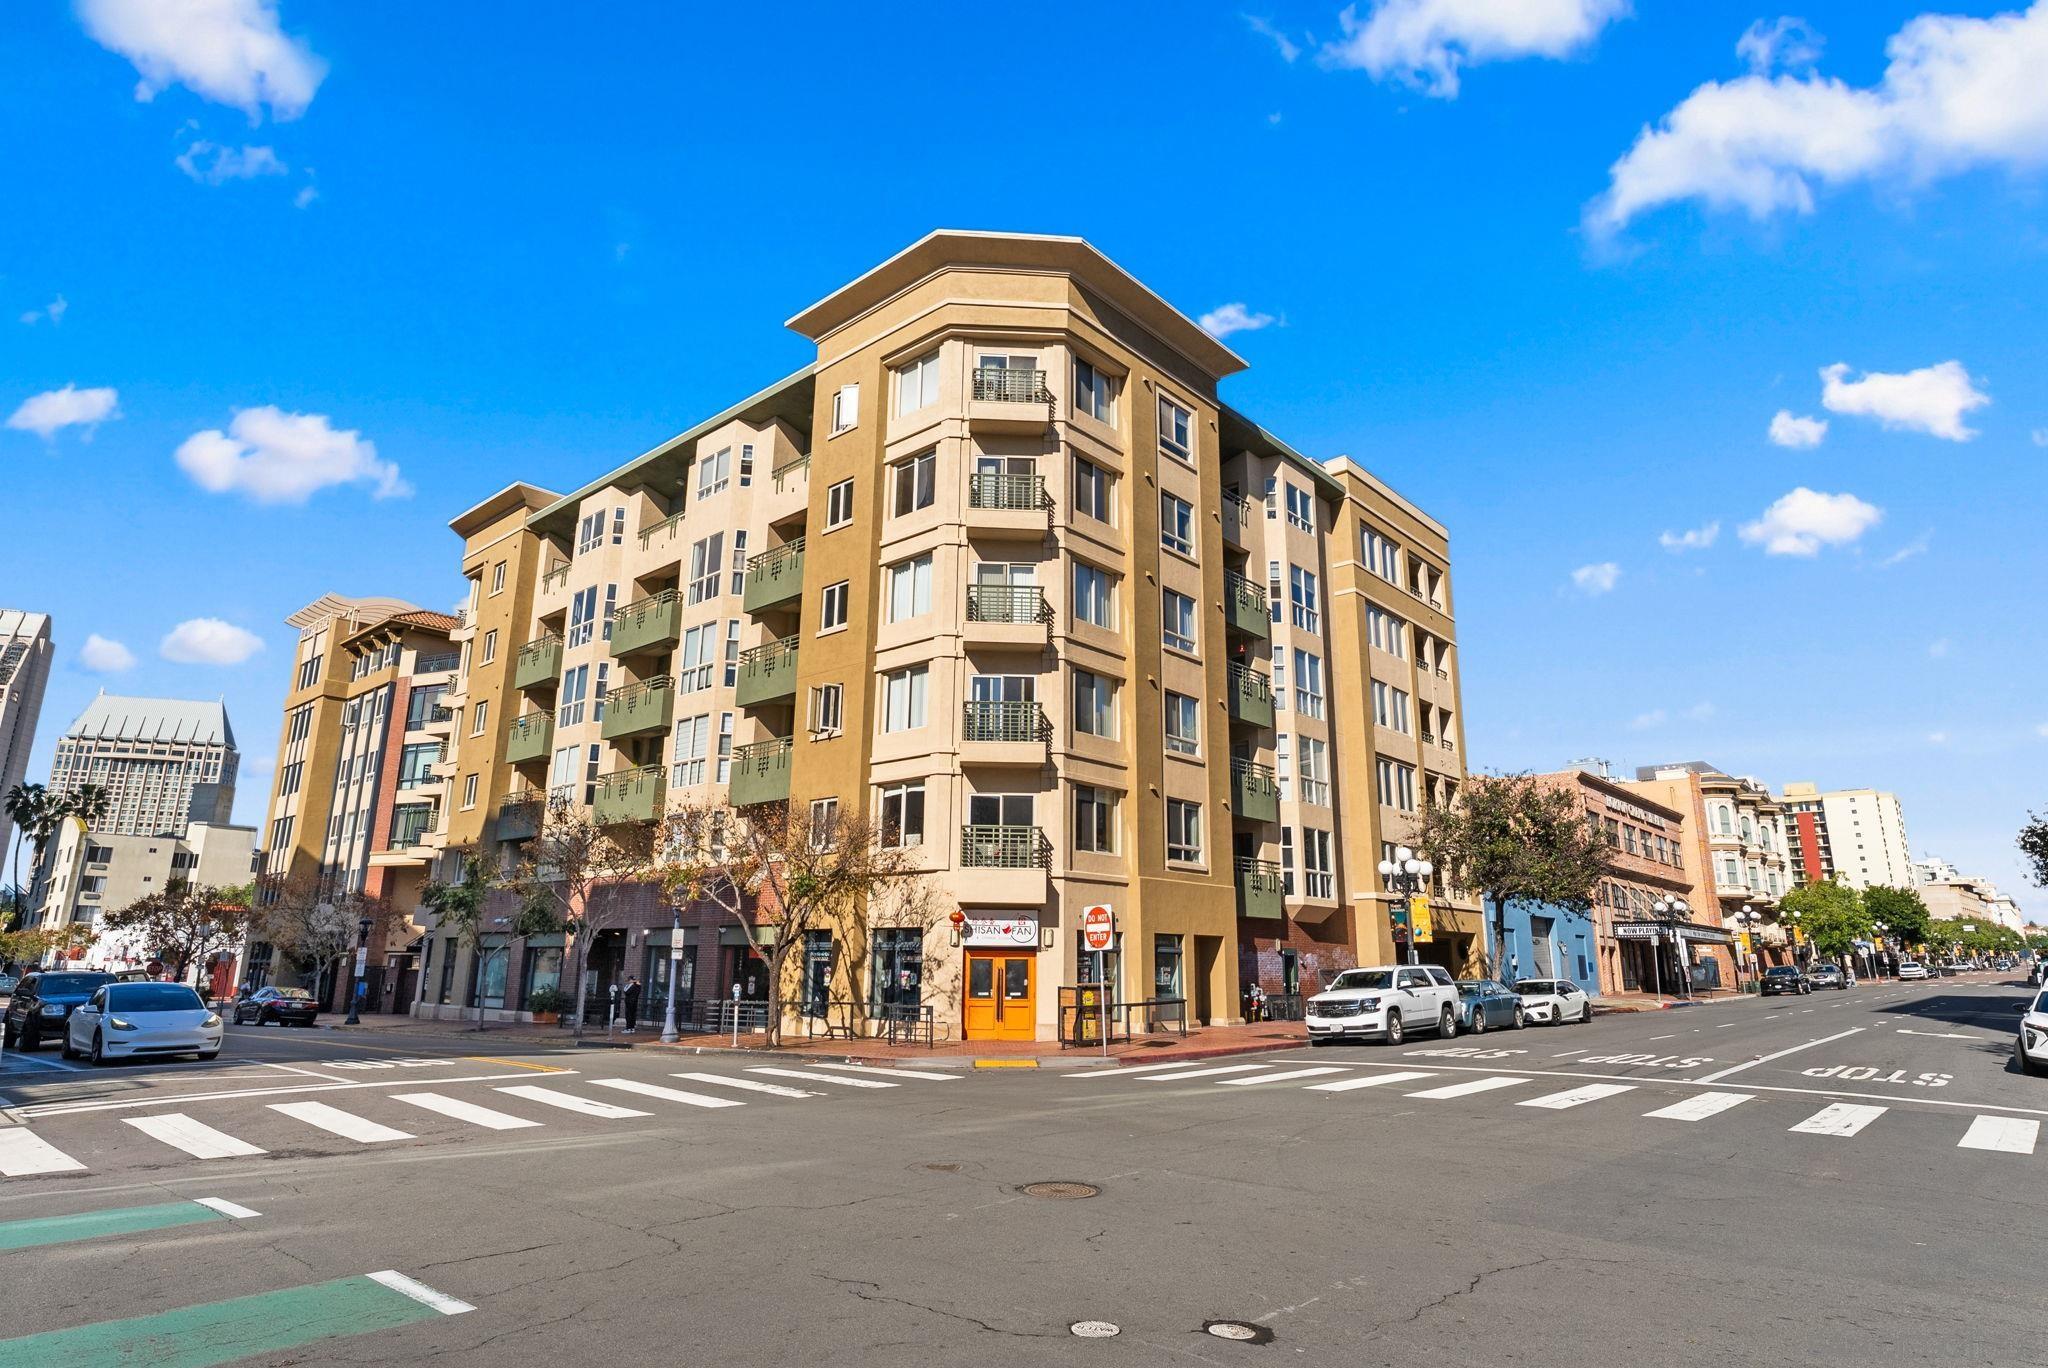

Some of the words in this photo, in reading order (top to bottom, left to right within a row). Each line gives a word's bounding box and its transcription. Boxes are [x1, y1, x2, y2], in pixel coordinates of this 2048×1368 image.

[1087, 914, 1096, 922] DO
[1097, 913, 1108, 922] NOT
[964, 925, 1001, 935] SHISAN
[1011, 926, 1032, 936] FAN
[1089, 932, 1108, 942] ENTER
[1577, 1053, 1715, 1068] STOP
[1800, 1065, 1954, 1087] STOP
